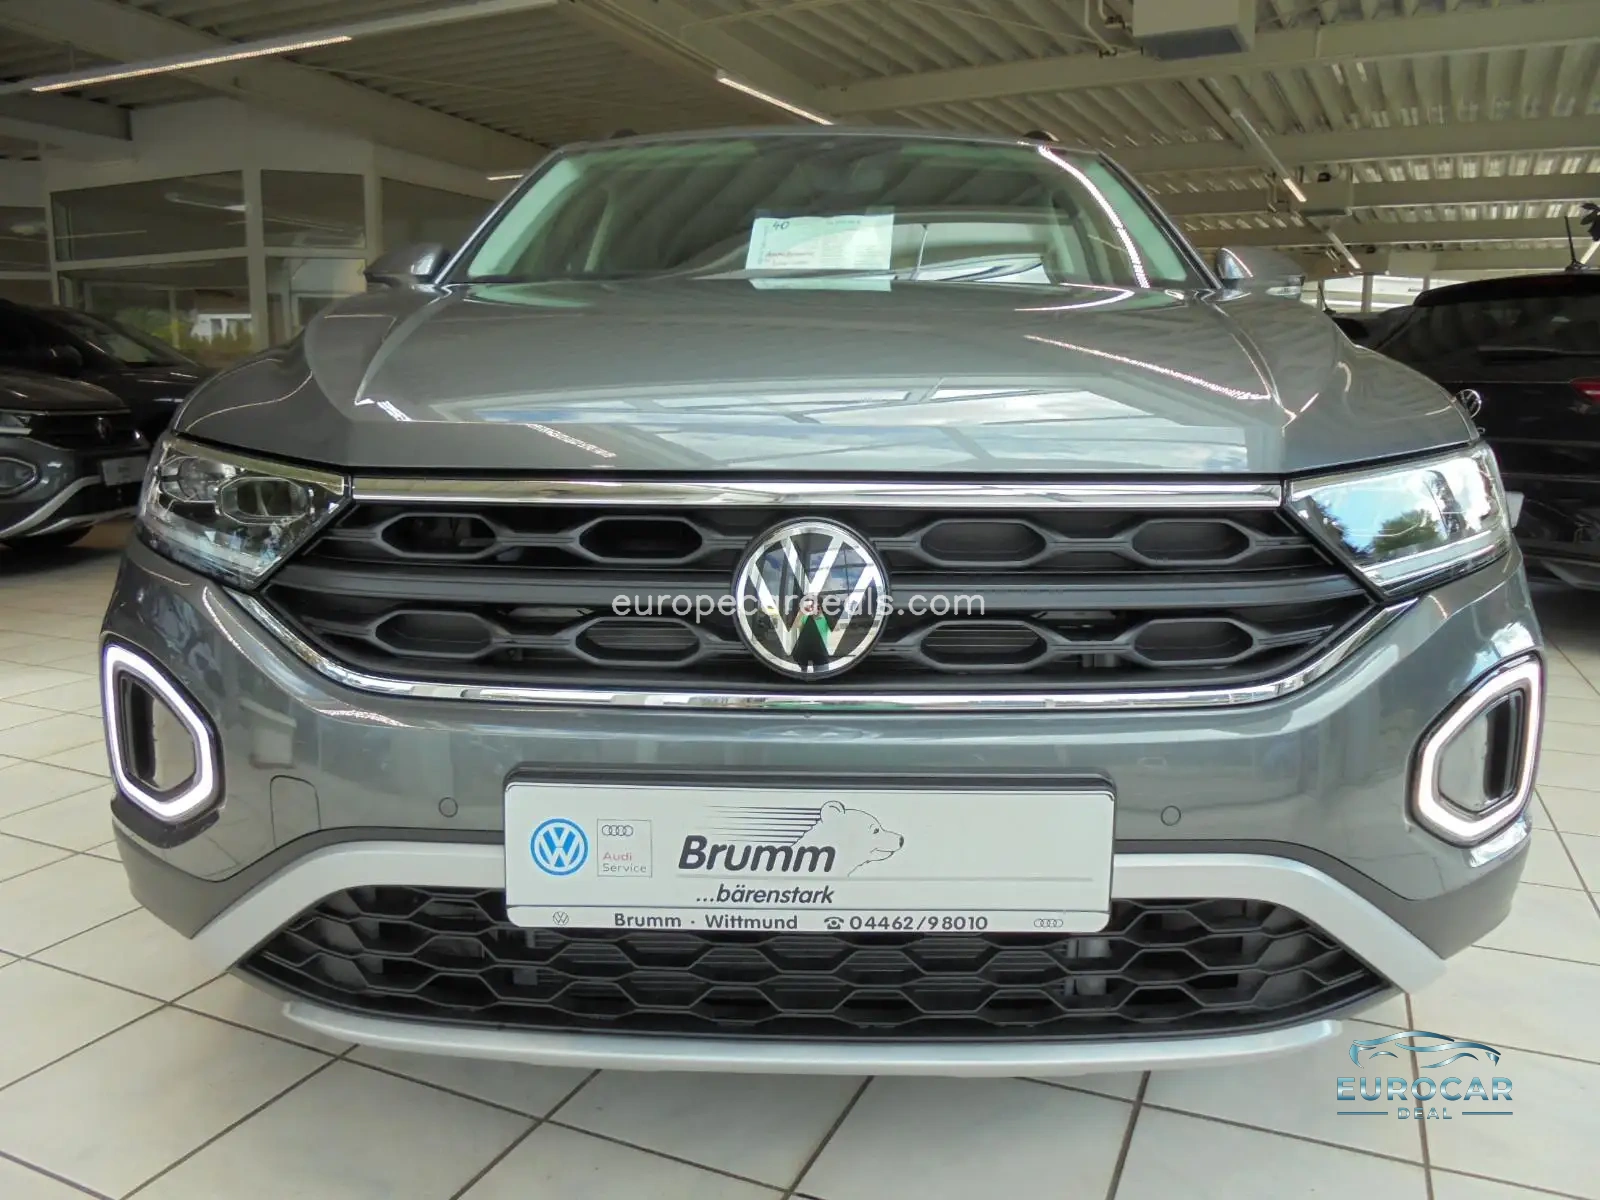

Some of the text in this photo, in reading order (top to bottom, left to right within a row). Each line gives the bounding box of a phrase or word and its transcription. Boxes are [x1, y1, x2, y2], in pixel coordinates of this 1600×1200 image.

[602, 851, 633, 862] Audi
[678, 835, 836, 873] Brumm
[602, 862, 648, 873] Service
[614, 912, 989, 931] Brumm Wittmund 04462/98010
